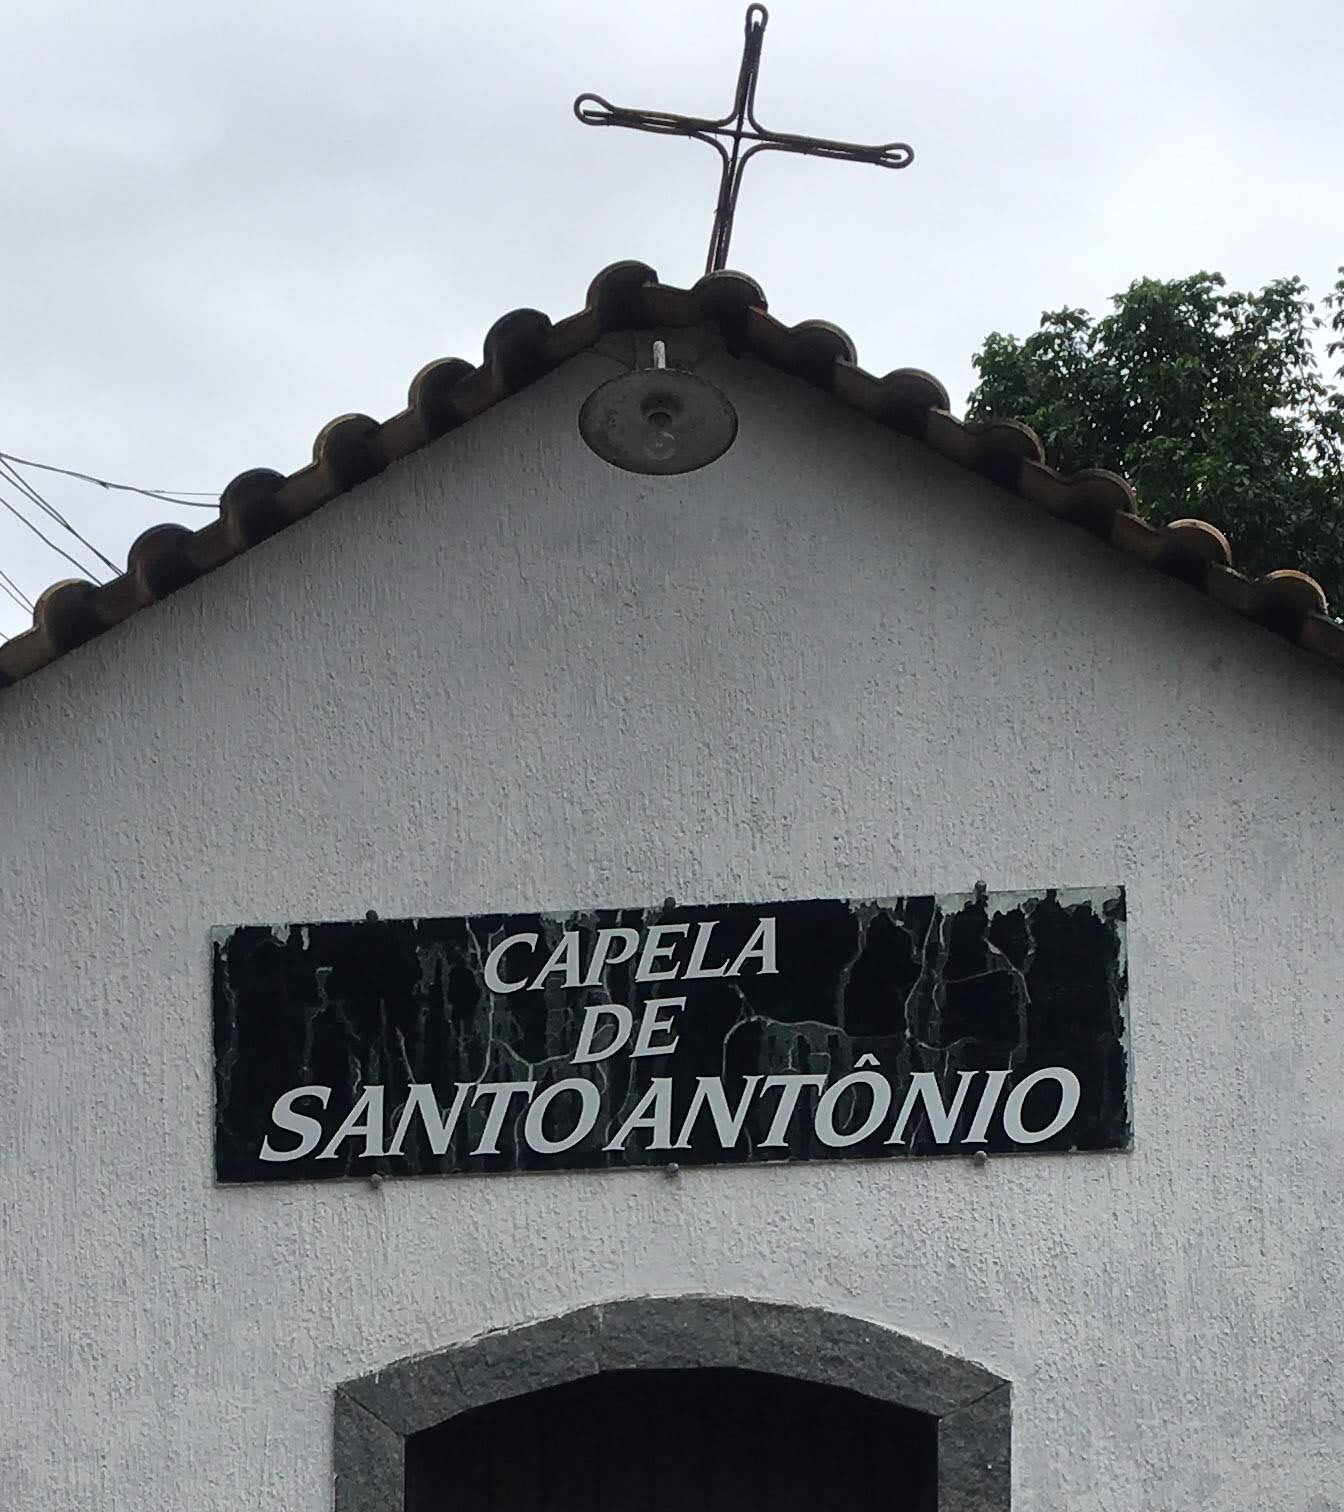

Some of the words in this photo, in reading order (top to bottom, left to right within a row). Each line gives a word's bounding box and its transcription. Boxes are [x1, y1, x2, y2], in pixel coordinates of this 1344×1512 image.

[482, 915, 781, 997] CAPELA
[568, 996, 687, 1066] DE
[258, 1075, 609, 1163] SANTO
[603, 1055, 1083, 1153] ANTÔNIO
